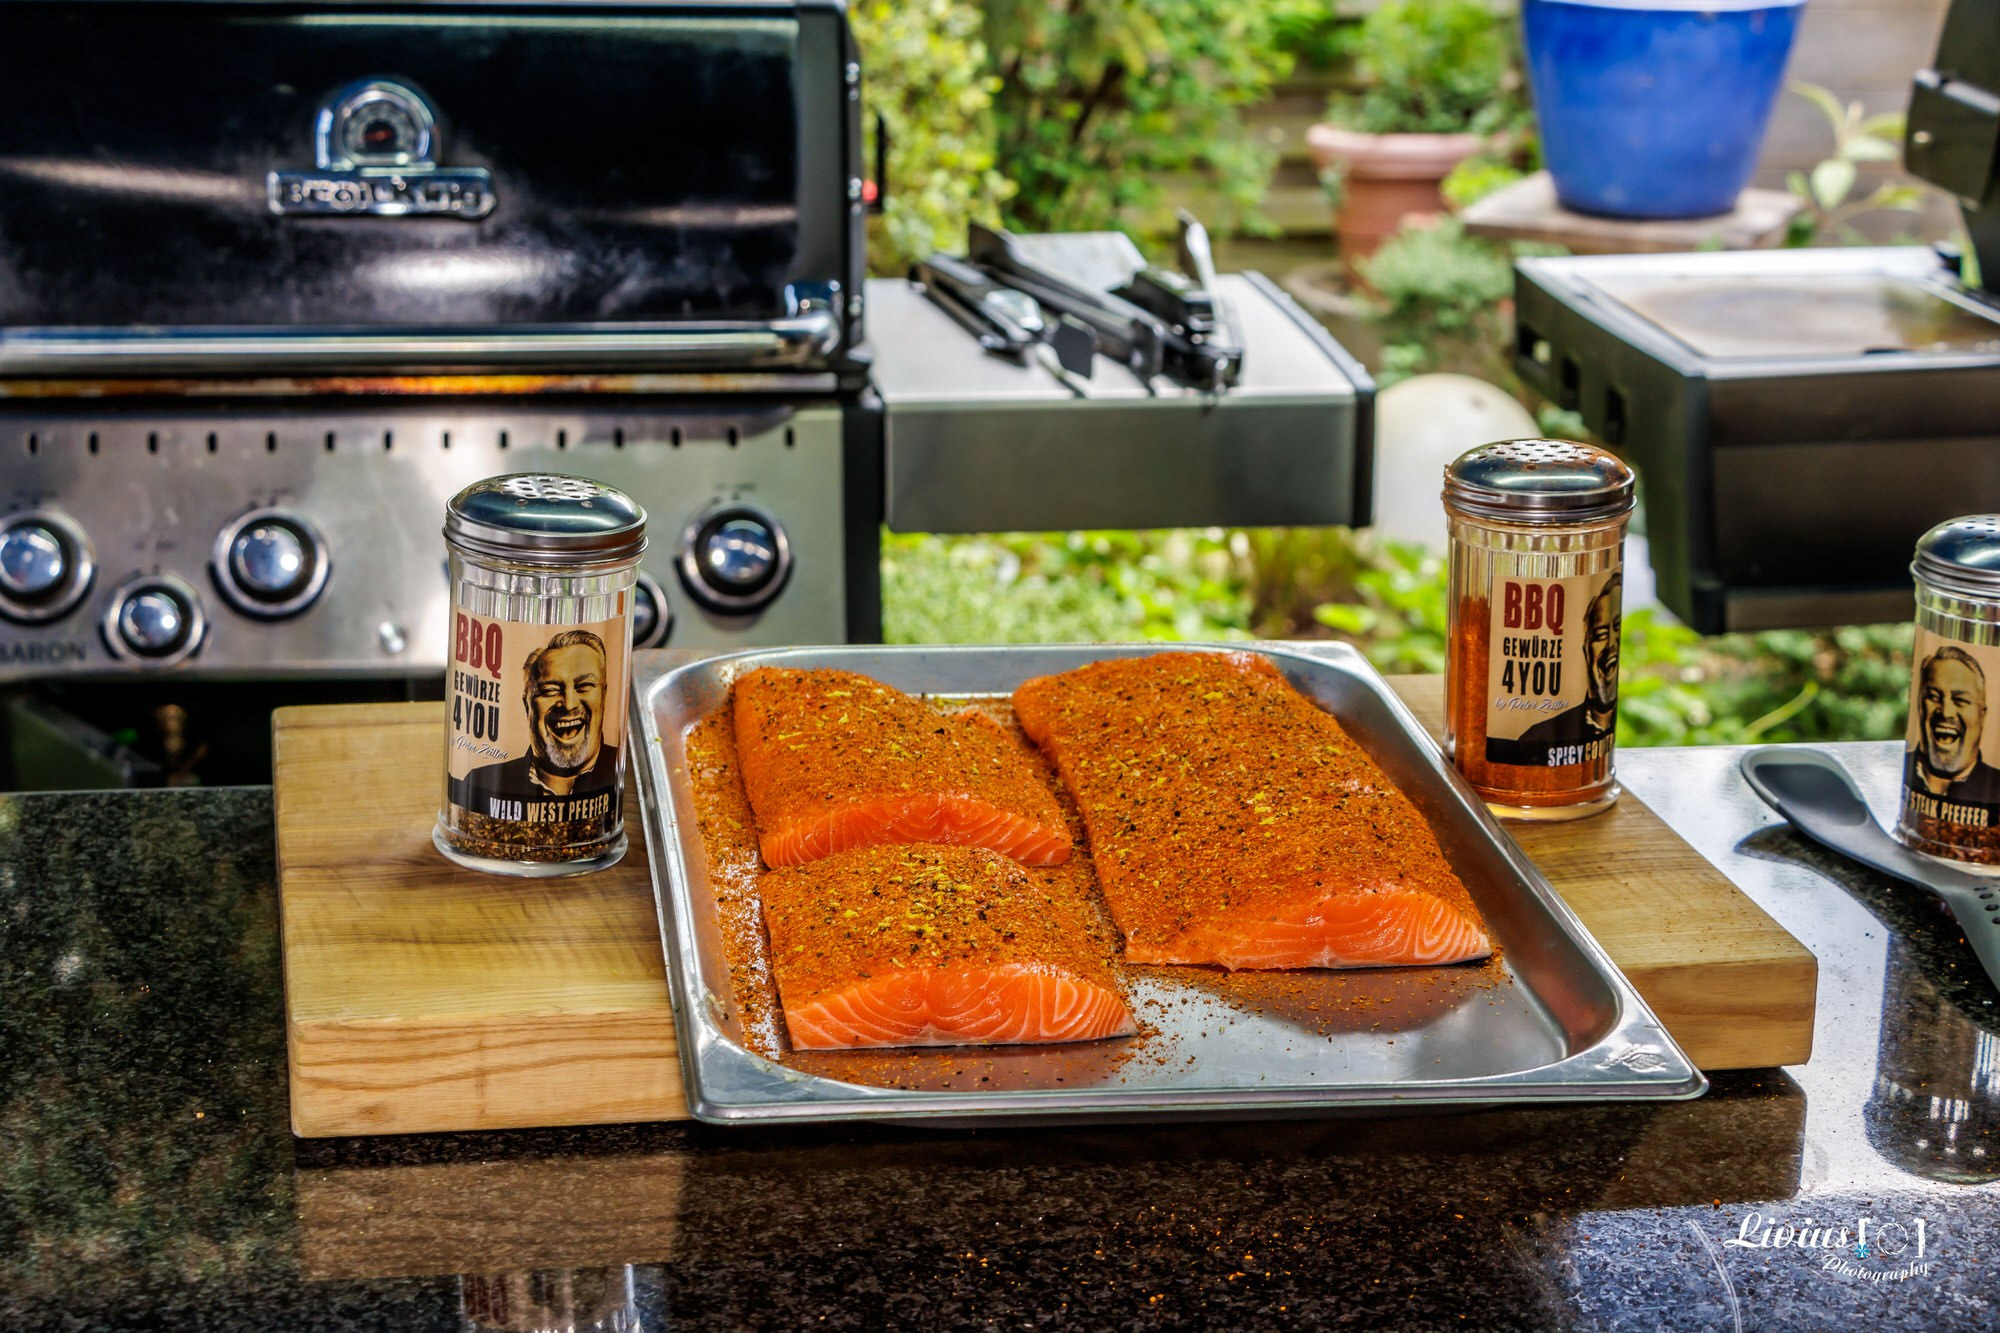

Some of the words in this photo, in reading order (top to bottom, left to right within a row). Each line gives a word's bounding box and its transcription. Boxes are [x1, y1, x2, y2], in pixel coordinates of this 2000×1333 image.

[1503, 582, 1565, 636] BBQ
[455, 612, 503, 679] BBQ
[1503, 635, 1562, 660] GEWÜRZE
[454, 669, 501, 703] GEWÜRZE
[1502, 660, 1561, 696] 4YOU
[453, 695, 500, 742] 4YOU
[1547, 744, 1584, 767] SPICY
[489, 797, 522, 821] WILD
[527, 800, 565, 823] WEST
[568, 793, 610, 821] PFEFFER
[1910, 791, 1939, 818] STEAK
[1941, 803, 1988, 827] PFEFFER
